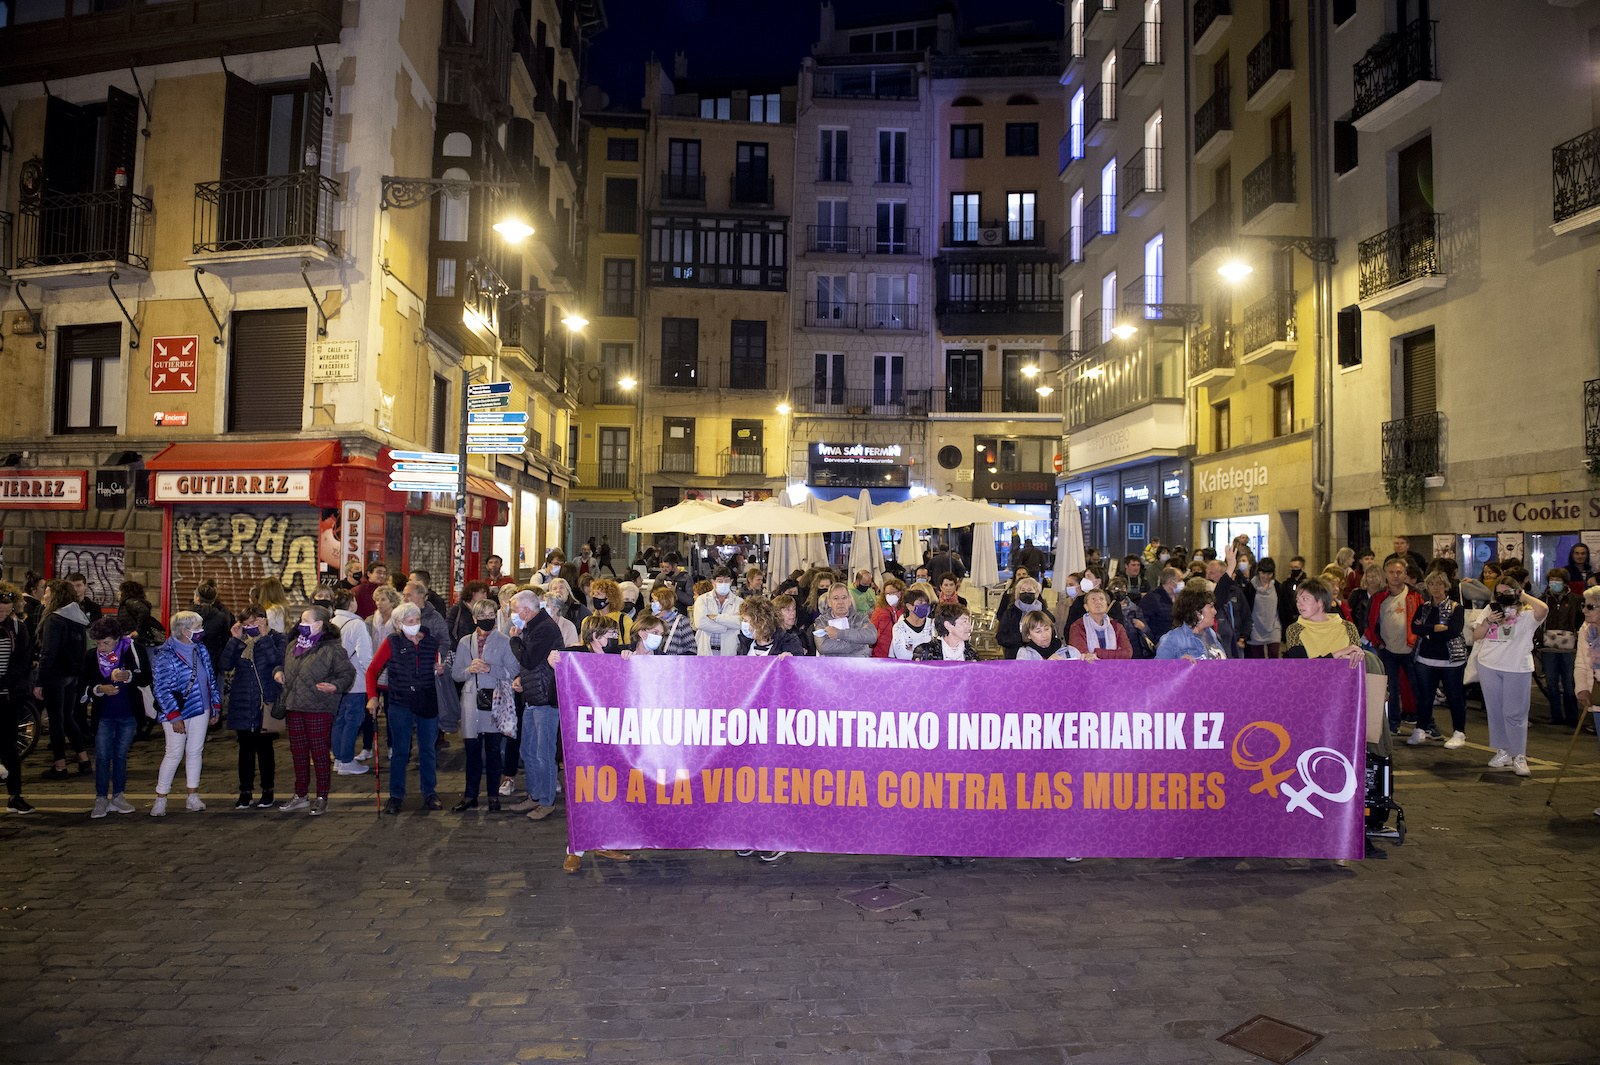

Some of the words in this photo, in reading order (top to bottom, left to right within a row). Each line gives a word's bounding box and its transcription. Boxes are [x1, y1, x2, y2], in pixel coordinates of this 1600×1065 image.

[154, 360, 195, 369] GUTIERREZ
[176, 475, 290, 495] GUTIERREZ
[1199, 461, 1269, 494] Kafetegia
[1473, 502, 1508, 524] The
[1512, 498, 1582, 522] Cookie
[577, 706, 768, 746] EMAKUMEON
[776, 708, 940, 750] KONTRAKO
[948, 712, 1186, 750] INDARKERIARIK
[1193, 712, 1225, 750] EZ
[574, 765, 618, 803] NO
[626, 768, 647, 804] A
[655, 768, 693, 805] LA
[702, 766, 869, 807] VIOLENCIA
[877, 770, 1007, 810] CONTRA
[1016, 771, 1074, 810] LAS
[1083, 772, 1226, 810] MUJERES
